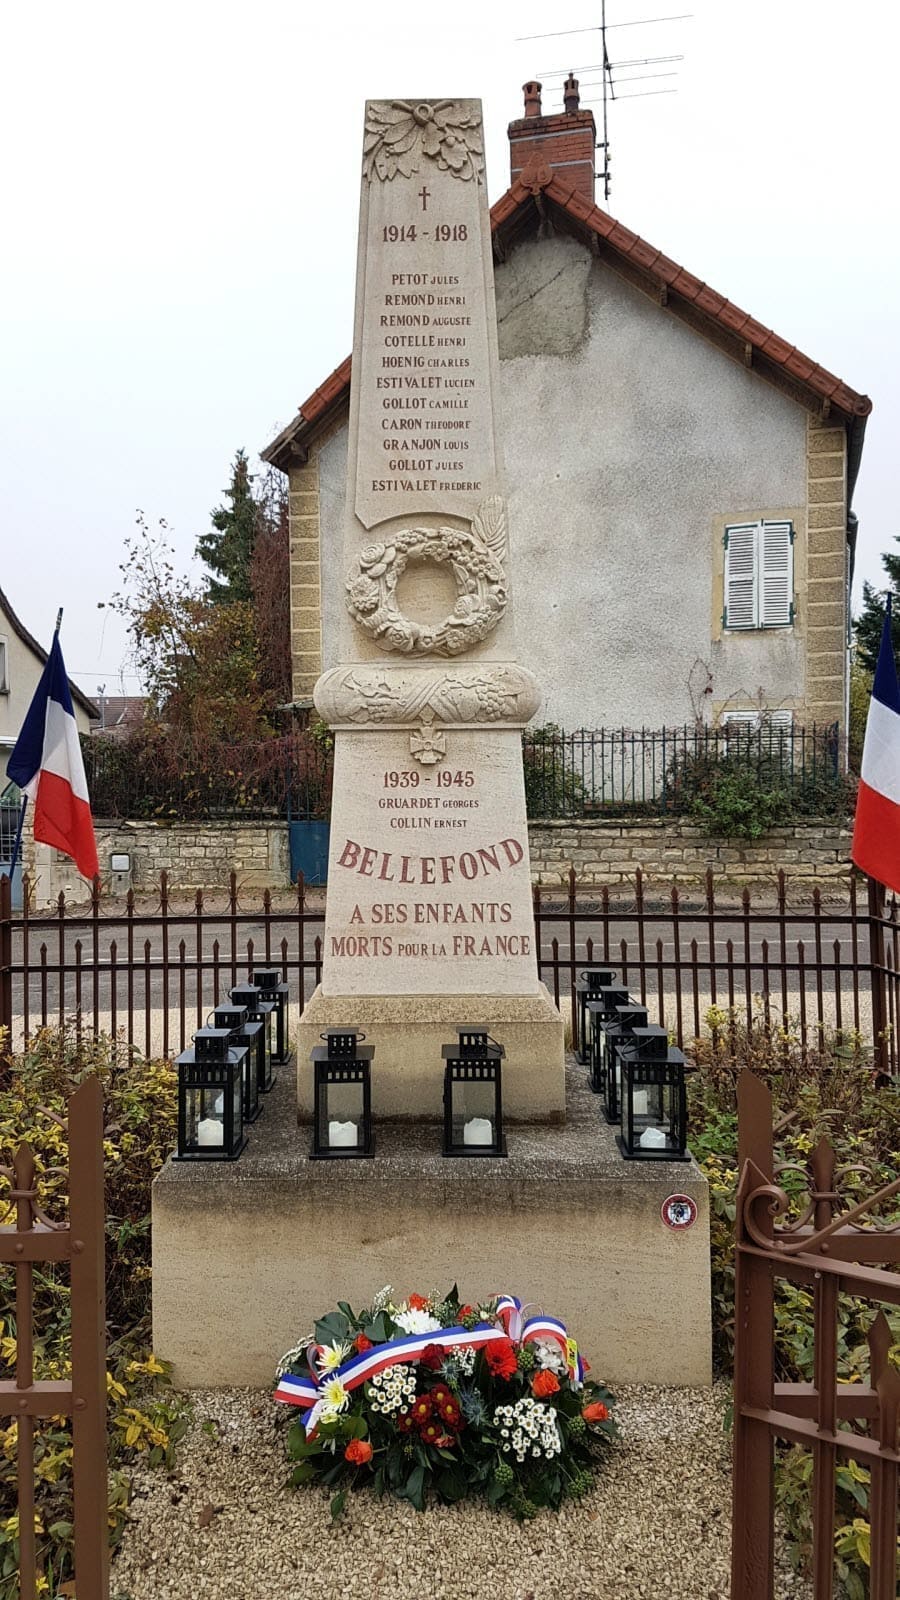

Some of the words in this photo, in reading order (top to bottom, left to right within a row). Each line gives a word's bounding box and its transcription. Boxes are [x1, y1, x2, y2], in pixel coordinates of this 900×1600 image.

[382, 225, 417, 243] 1914
[435, 224, 468, 242] 1918
[391, 273, 429, 285] PETOT
[430, 276, 459, 285] JULES
[384, 294, 435, 306] REMOND
[437, 296, 466, 305] HENRI
[380, 314, 430, 327] REMOND
[432, 316, 472, 326] AUGUSTE
[384, 335, 435, 347] COTELLE
[437, 338, 466, 347] HENRI
[382, 356, 425, 368] HOENIG
[427, 358, 470, 367] CHARLES
[376, 377, 442, 388] ESTIVALET
[444, 379, 475, 388] LUCIEN
[382, 398, 427, 409] GOLLOT
[428, 399, 469, 409] CAMILLE
[381, 418, 422, 430] CARON
[424, 420, 472, 429] THEODORE
[382, 439, 441, 450] GRANJON
[443, 440, 469, 450] LOUIS
[388, 459, 433, 471] GOLLOT
[435, 461, 464, 470] JULES
[371, 480, 437, 491] ESTIVALET
[439, 482, 481, 491] FREDERIC
[383, 771, 420, 788] 1939
[436, 770, 475, 788] 1945
[378, 798, 440, 809] GRUARDET
[442, 799, 479, 809] GEORGES
[390, 817, 431, 829] COLLIN
[434, 819, 467, 828] ERNEST
[336, 838, 524, 885] BELLEFOND
[350, 903, 364, 924] A
[371, 903, 408, 924] SES
[414, 902, 512, 924] ENFANTS
[331, 936, 393, 958] MORTS
[397, 943, 428, 957] POUR
[432, 943, 447, 956] LA
[452, 935, 530, 957] FRANCE
